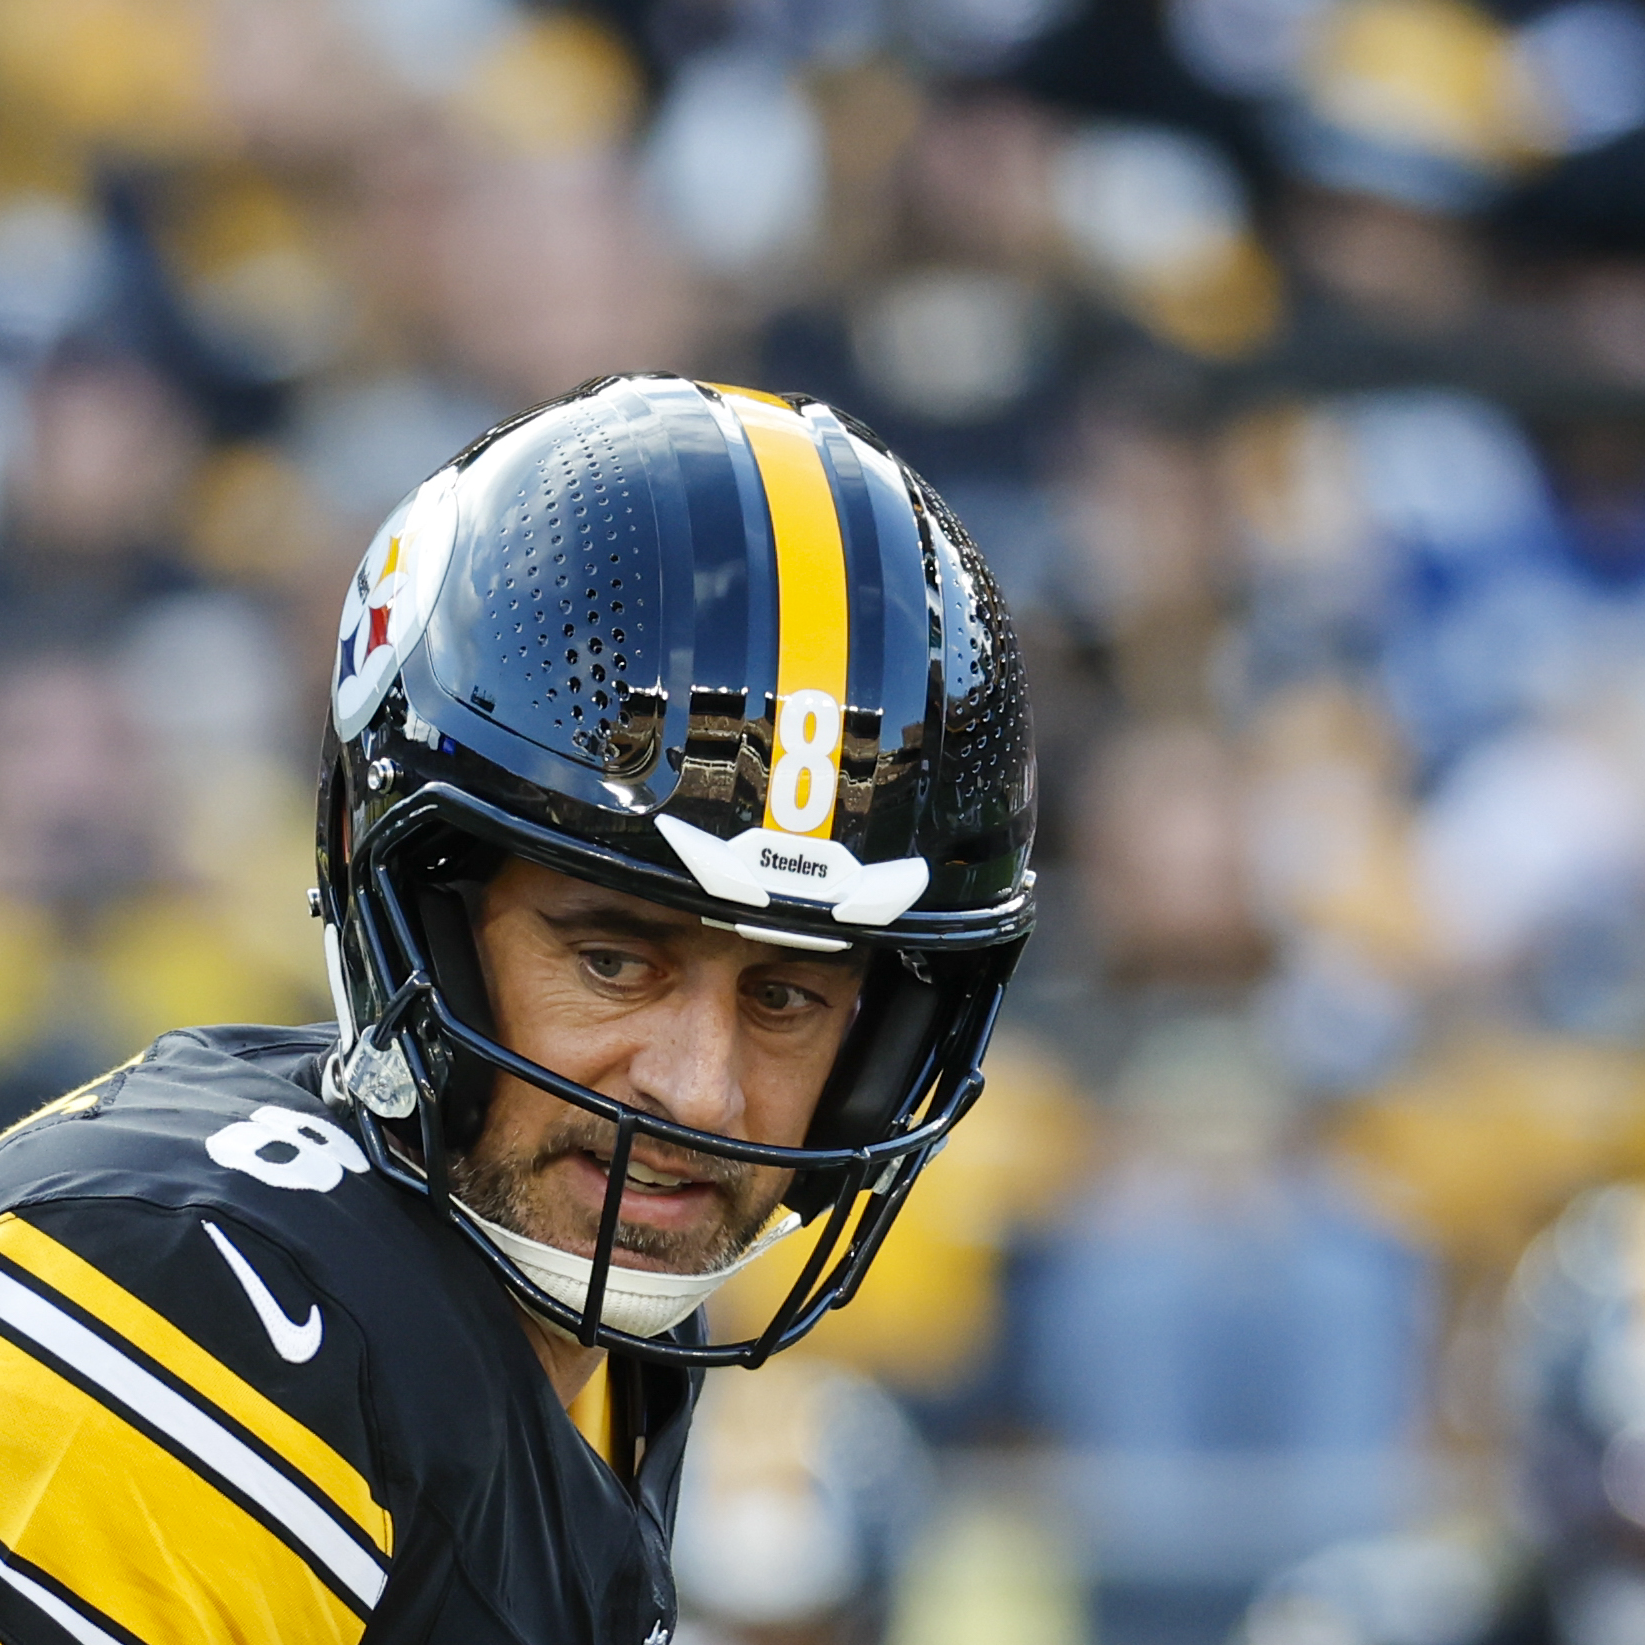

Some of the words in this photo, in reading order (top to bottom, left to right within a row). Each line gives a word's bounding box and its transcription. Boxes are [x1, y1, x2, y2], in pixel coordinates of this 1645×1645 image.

[769, 688, 842, 833] 8
[758, 847, 829, 880] Steelers
[205, 1105, 371, 1194] 8
